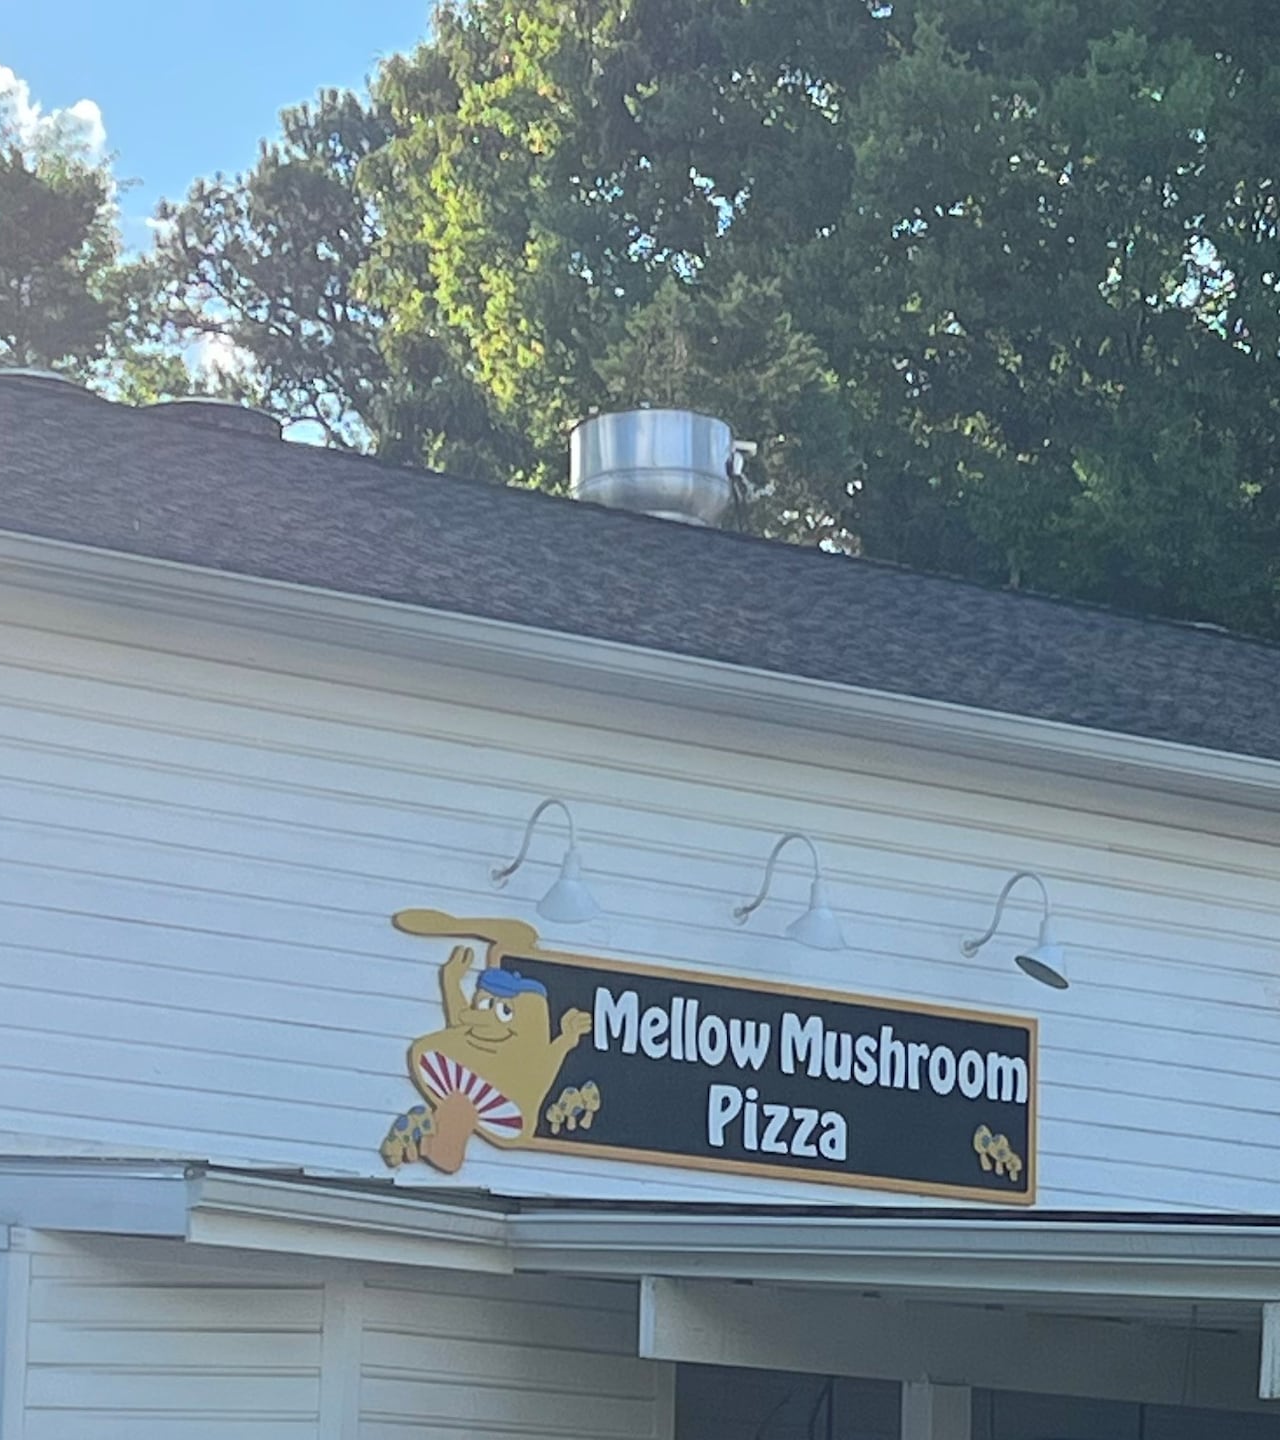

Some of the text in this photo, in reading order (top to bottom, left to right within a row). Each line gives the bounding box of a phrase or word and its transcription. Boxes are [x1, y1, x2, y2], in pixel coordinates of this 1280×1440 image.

[593, 987, 1028, 1104] Mellow Mushroom
[708, 1083, 847, 1161] Pizza
